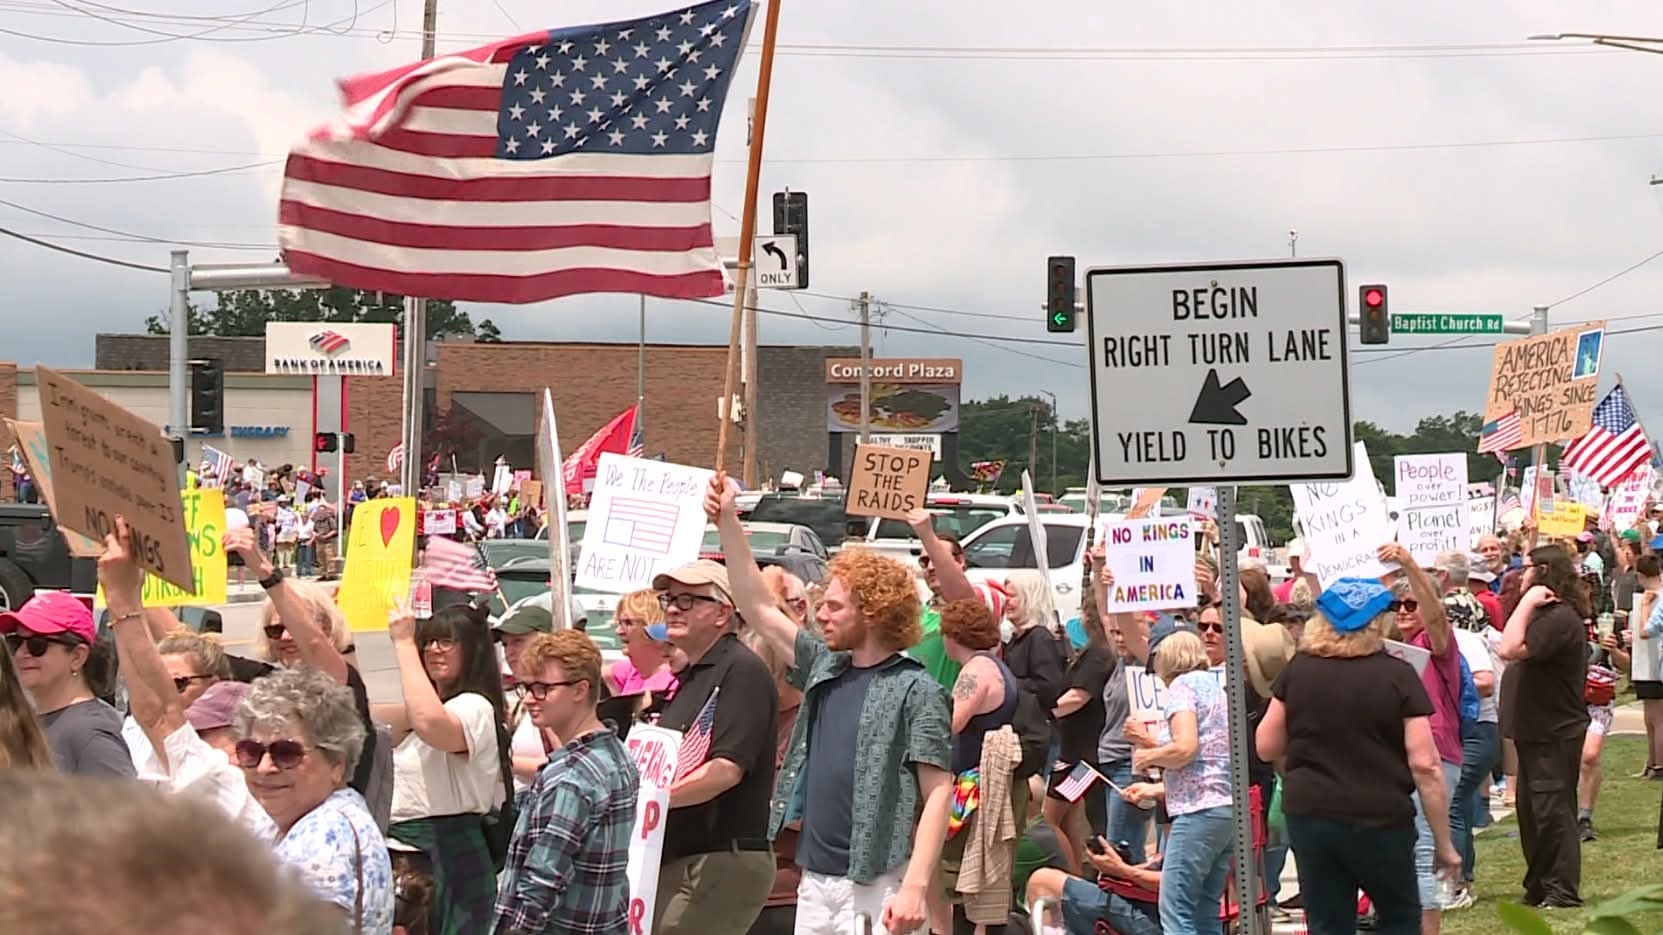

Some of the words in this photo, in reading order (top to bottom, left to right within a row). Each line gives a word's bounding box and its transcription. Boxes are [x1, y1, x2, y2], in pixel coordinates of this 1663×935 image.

[761, 273, 791, 284] ONLY
[1172, 286, 1258, 320] BEGIN
[1394, 316, 1437, 332] Baptist
[1440, 316, 1483, 330] Church
[1487, 319, 1500, 330] Rd
[1103, 335, 1171, 368] RIGHT
[1188, 331, 1249, 365] TURN
[1268, 329, 1332, 362] LANE
[1498, 336, 1569, 375] AMERICA
[274, 359, 307, 369] BANK
[310, 359, 326, 369] OF
[329, 359, 383, 369] AMERICA
[909, 363, 954, 377] Plaza
[1494, 365, 1572, 403] REJECTING
[1513, 393, 1553, 418] KINGS
[1560, 383, 1597, 406] SINCE
[1531, 410, 1572, 438] 1776
[1118, 431, 1186, 463] YIELD
[1207, 428, 1235, 460] TO
[1258, 425, 1327, 459] BIKES
[864, 453, 919, 474] STOP
[1400, 459, 1456, 482] People
[606, 464, 624, 487] We
[632, 467, 654, 492] The
[660, 471, 698, 498] People
[872, 473, 904, 490] THE
[857, 489, 915, 512] RAIDS
[1112, 527, 1131, 544] NO
[1143, 522, 1189, 542] KINGS
[1306, 499, 1366, 537] KINGS
[114, 514, 164, 572] KNGS
[584, 552, 616, 581] ARE
[619, 554, 661, 584] NOT
[1139, 555, 1154, 573] IN
[1317, 550, 1378, 582] DEMOCRAC
[1115, 583, 1185, 603] AMERICA
[1132, 671, 1164, 711] ICE
